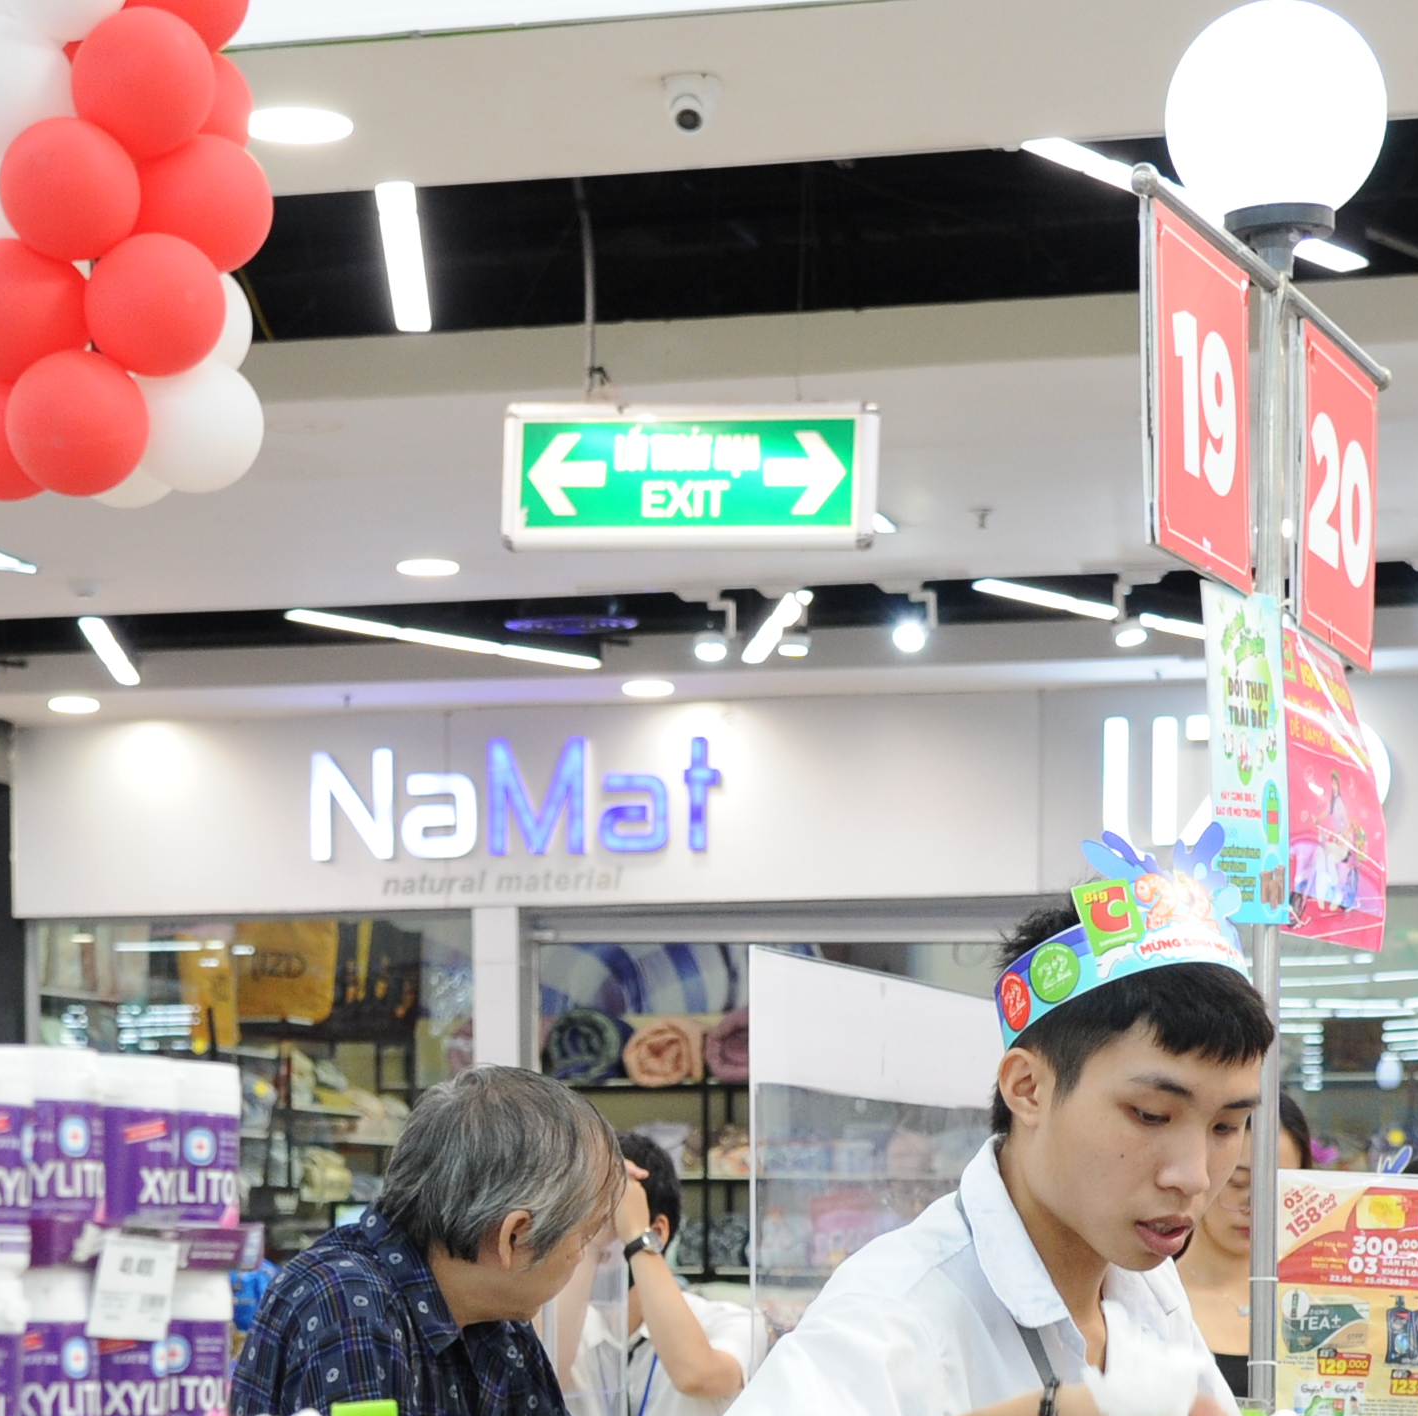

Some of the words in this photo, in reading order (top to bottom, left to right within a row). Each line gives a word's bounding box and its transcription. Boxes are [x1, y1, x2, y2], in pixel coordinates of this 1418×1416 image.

[1172, 310, 1237, 496] 19
[641, 480, 731, 518] EXIT
[1308, 412, 1372, 588] 20
[310, 735, 722, 862] NaMat
[382, 868, 483, 897] natural
[496, 865, 622, 894] material
[1083, 890, 1108, 905] Big
[1140, 937, 1181, 956] MỪNG
[1348, 1255, 1378, 1275] 03
